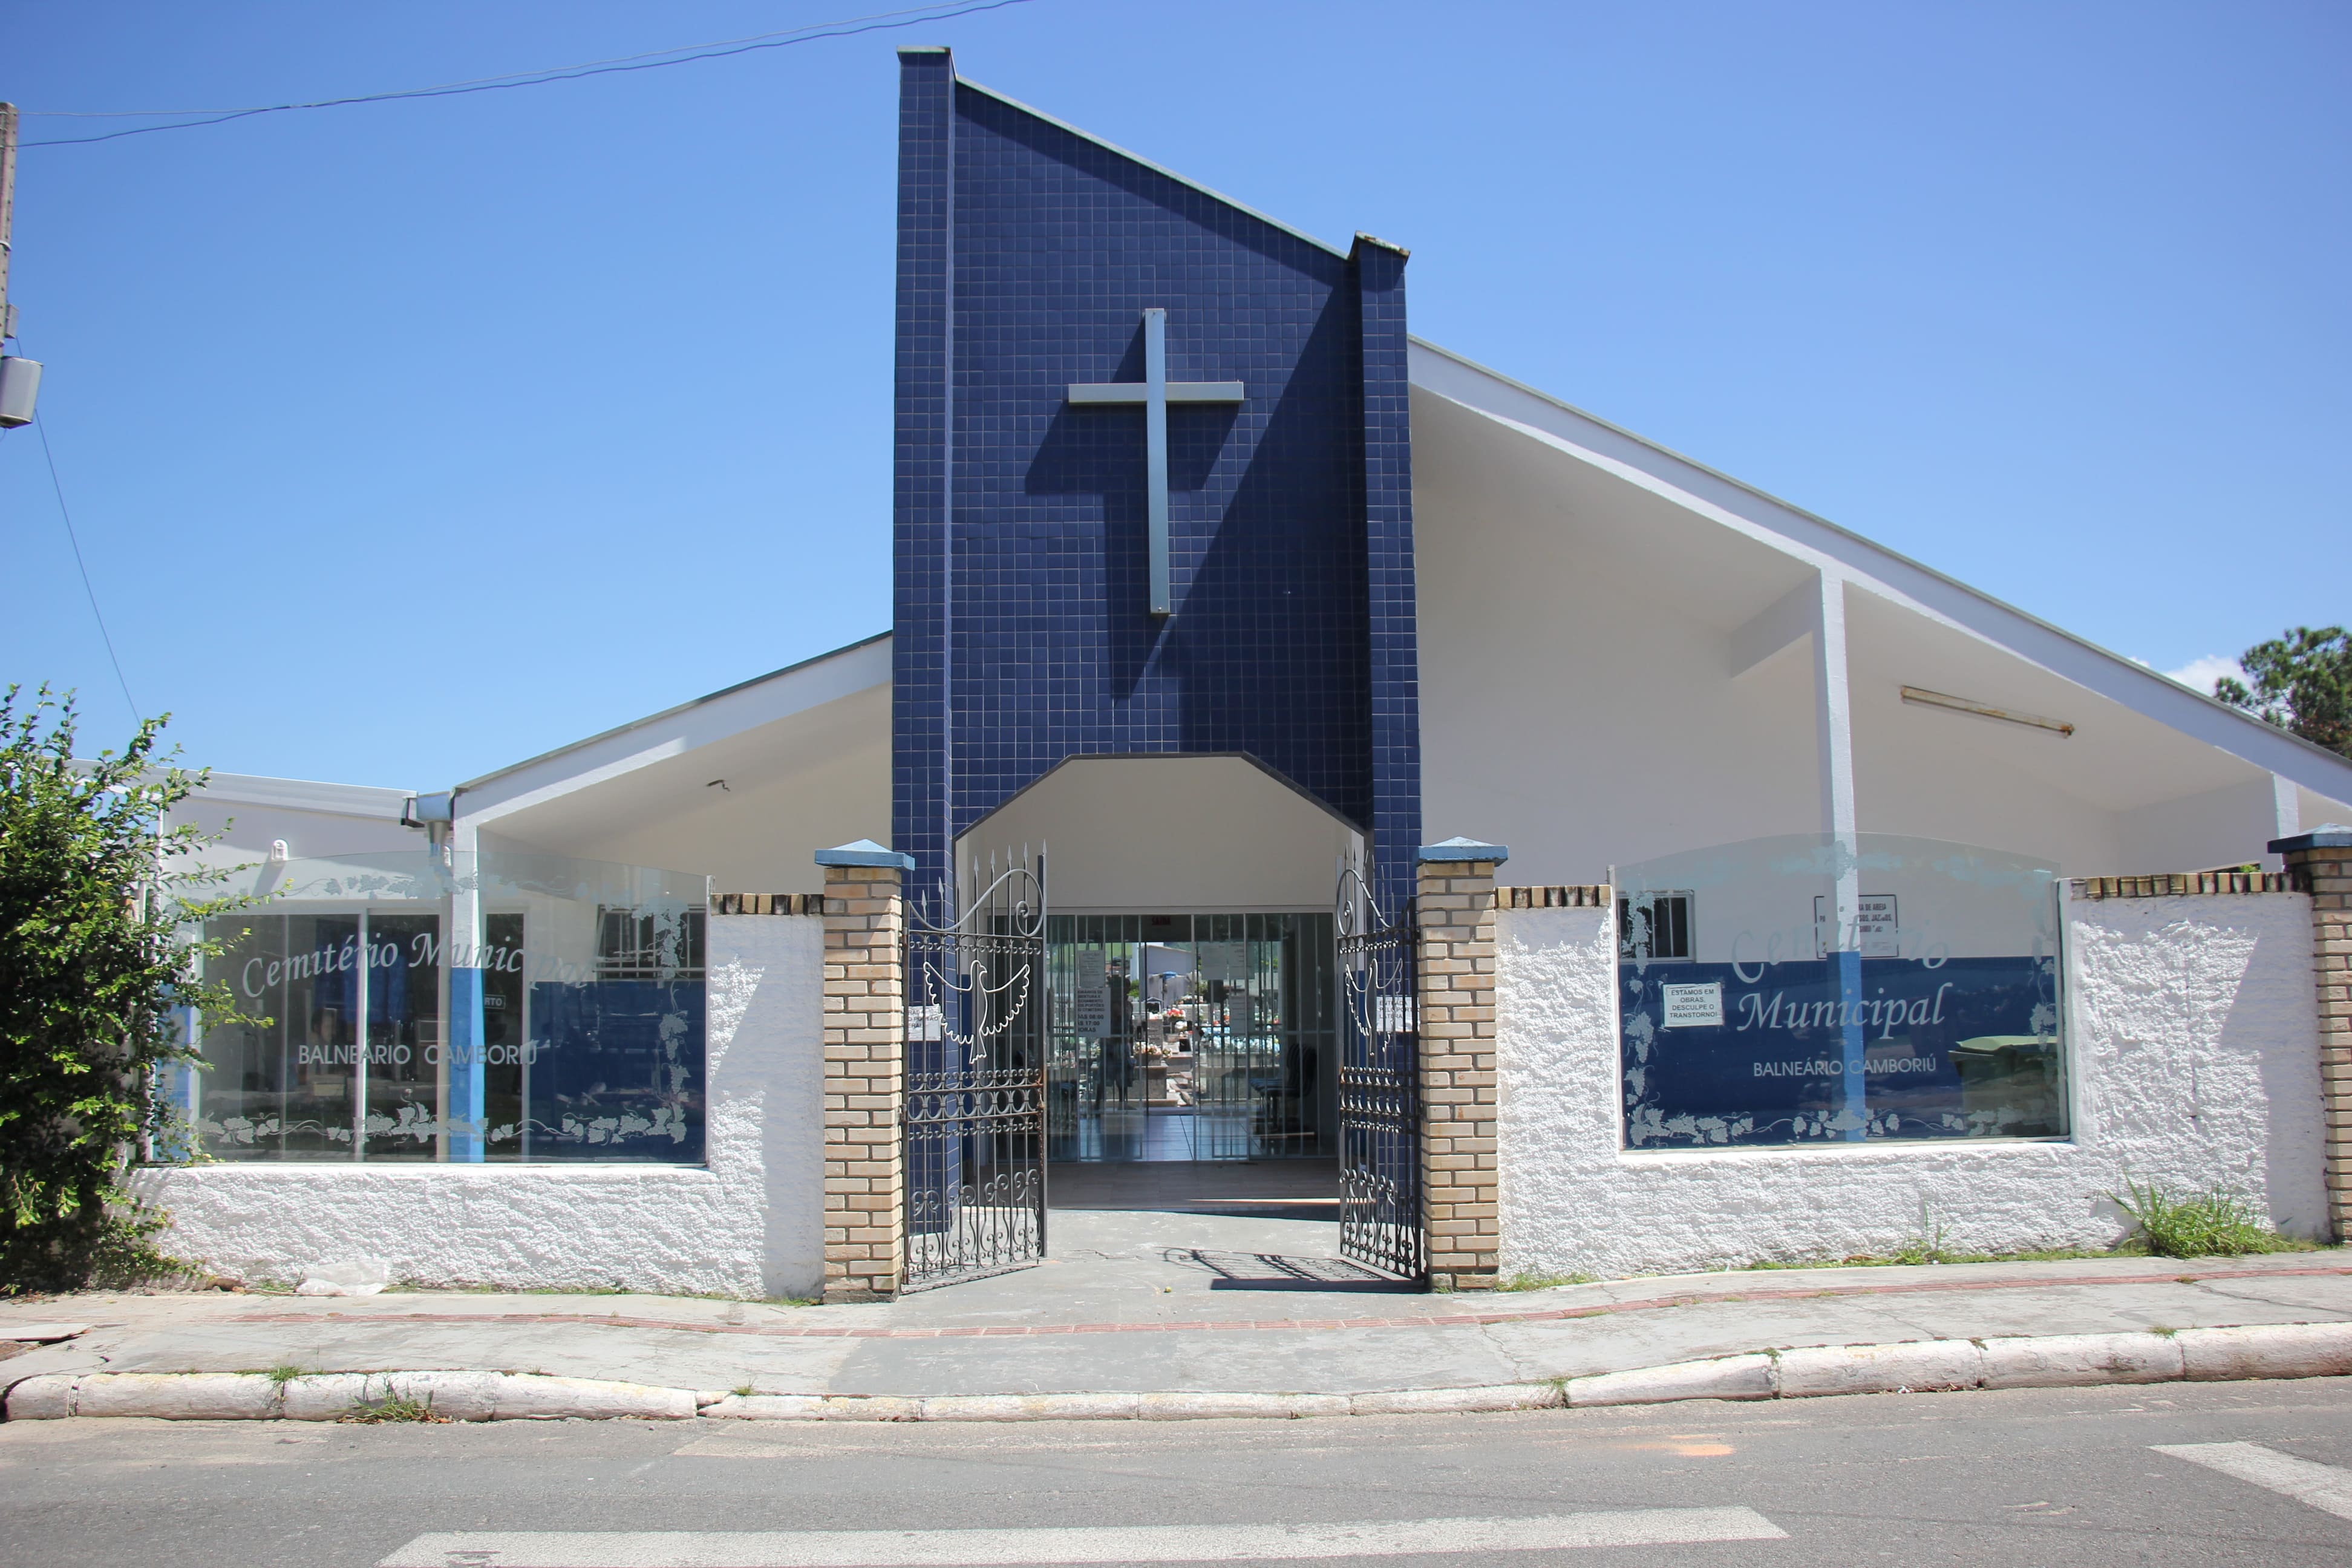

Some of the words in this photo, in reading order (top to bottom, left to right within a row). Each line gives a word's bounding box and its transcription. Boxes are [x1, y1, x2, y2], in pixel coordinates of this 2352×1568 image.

[243, 932, 399, 998] Cemitério
[1736, 982, 1953, 1040] Municipal
[1753, 1057, 1844, 1077] BALNEÁRIO
[1848, 1053, 1936, 1076] CAMBORIÚ
